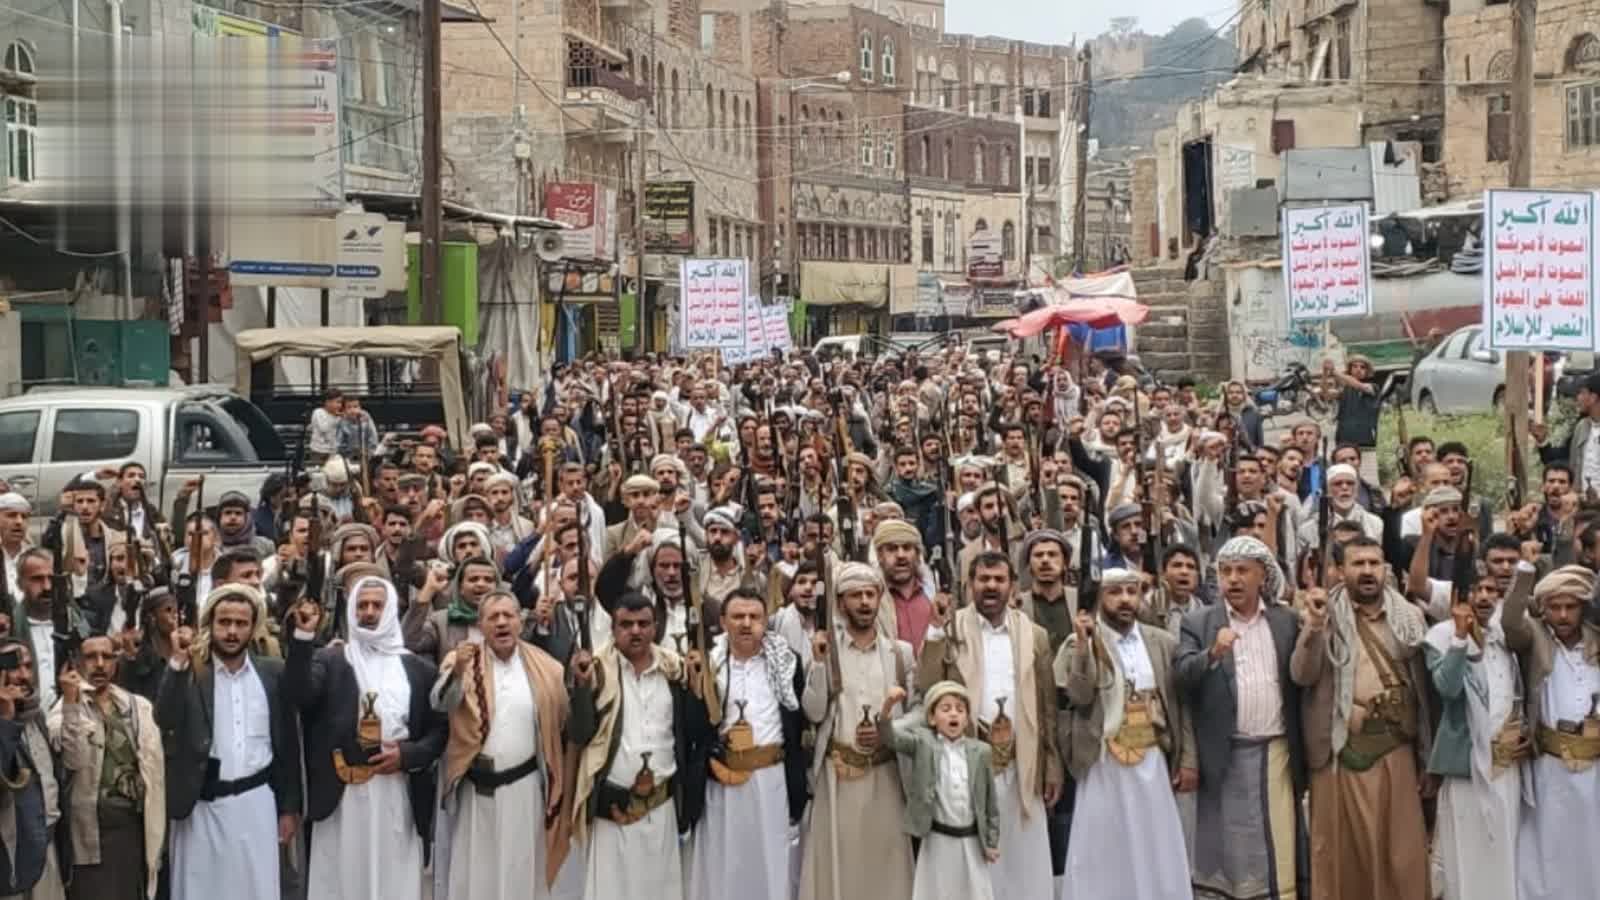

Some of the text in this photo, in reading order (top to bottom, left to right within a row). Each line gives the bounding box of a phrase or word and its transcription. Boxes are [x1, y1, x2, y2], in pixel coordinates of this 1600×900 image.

[1292, 210, 1360, 237] الله أكبر
[1497, 196, 1588, 231] الله أكبر
[1548, 235, 1588, 255] الموت
[1548, 264, 1588, 282] الموت
[1294, 295, 1328, 313] للإسلام
[1333, 290, 1363, 312] النصر
[1495, 287, 1588, 309] اللعنة على اليهود
[1495, 313, 1588, 343] النصر للإسلام
